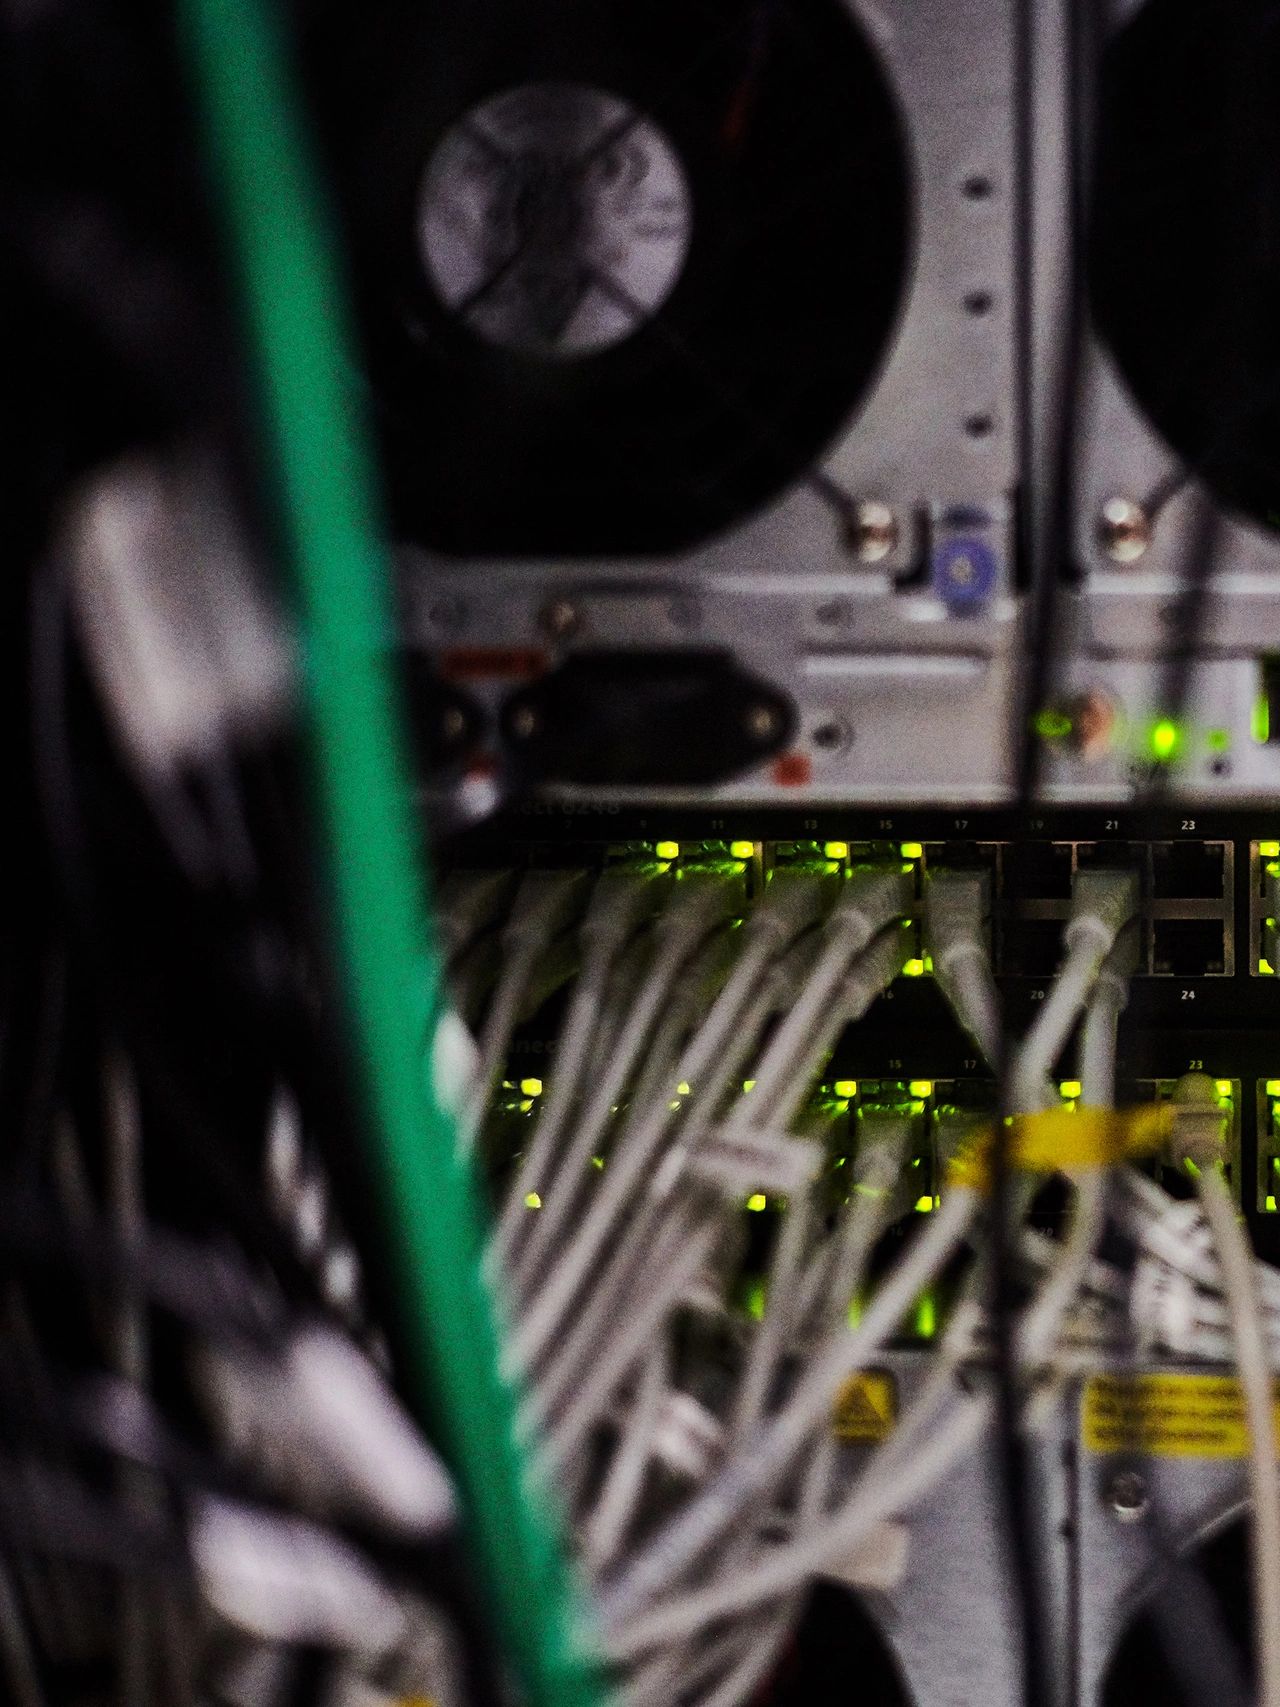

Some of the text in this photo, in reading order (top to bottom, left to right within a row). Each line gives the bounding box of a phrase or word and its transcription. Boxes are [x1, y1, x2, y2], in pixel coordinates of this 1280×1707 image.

[879, 819, 893, 830] 15
[954, 819, 969, 830] 17
[1105, 819, 1119, 830] 21
[1181, 819, 1196, 831] 23
[1030, 990, 1045, 1000] 20
[1181, 989, 1196, 1000] 24
[963, 1059, 977, 1070] 17
[1188, 1060, 1203, 1070] 23
